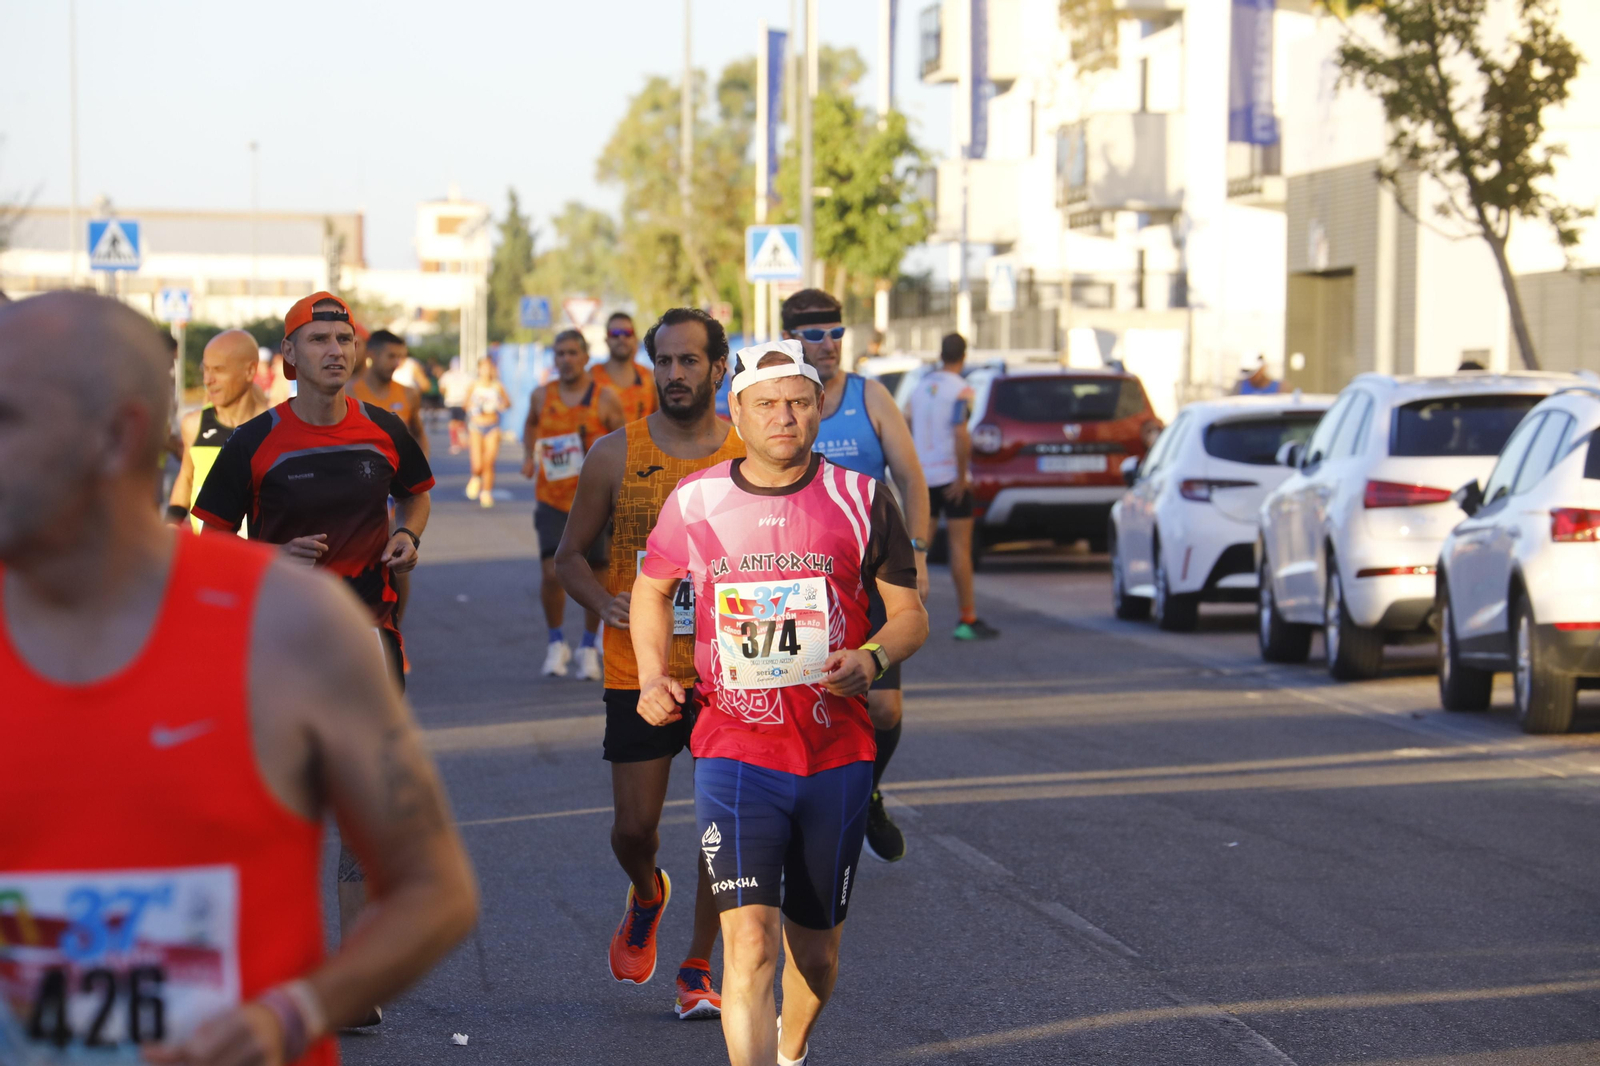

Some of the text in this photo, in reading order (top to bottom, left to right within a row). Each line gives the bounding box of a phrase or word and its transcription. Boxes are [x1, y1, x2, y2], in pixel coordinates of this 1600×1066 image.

[712, 551, 834, 577] LA ANTORCHA
[741, 618, 802, 659] 374
[27, 965, 168, 1050] 426
